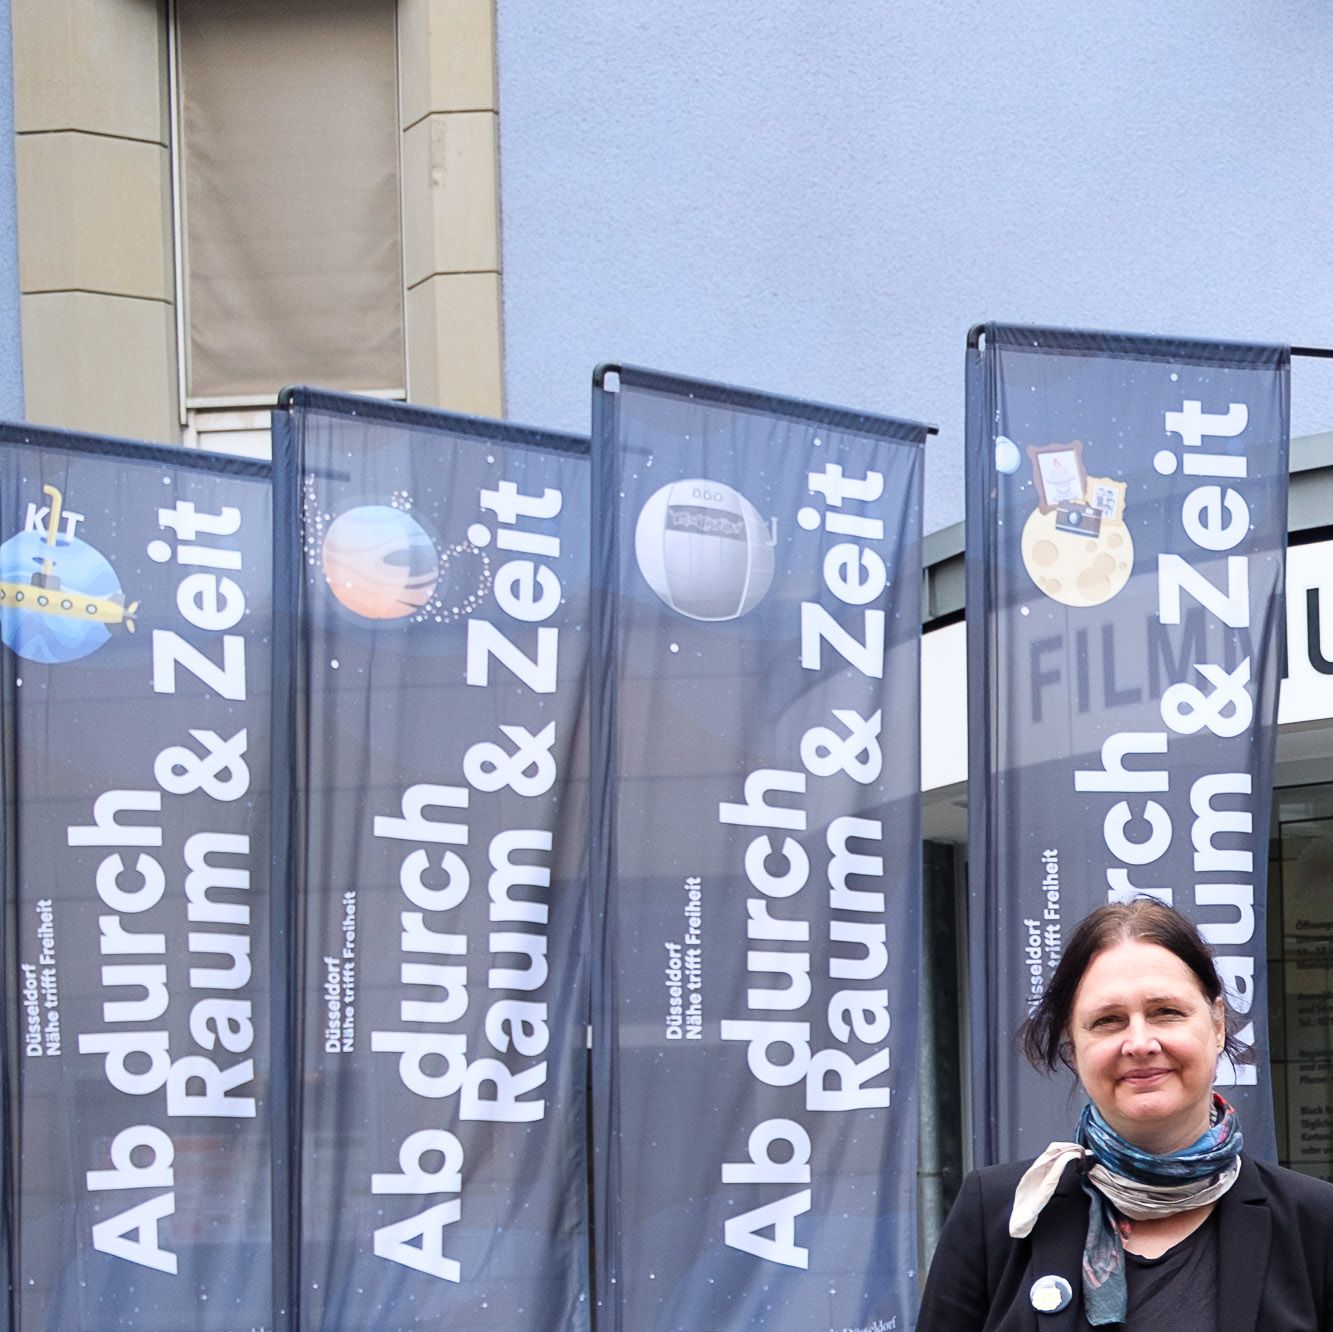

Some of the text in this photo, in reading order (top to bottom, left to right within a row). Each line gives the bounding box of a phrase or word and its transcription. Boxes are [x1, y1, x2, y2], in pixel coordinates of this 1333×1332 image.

[1154, 400, 1249, 627] Zeit
[1160, 656, 1253, 737] &
[147, 501, 256, 1117] Raum & Zeit
[459, 481, 562, 1122] Raum & Zeit
[797, 463, 890, 1111] Raum & Zeit
[684, 876, 702, 1040] Nähe trifft Freiheit
[1042, 848, 1060, 920] Freiheit
[21, 963, 43, 1057] Düsseldorf
[36, 898, 61, 1057] Nähe trifft Freiheit
[67, 790, 177, 1274] Ab durch
[324, 957, 341, 1053] Düsseldorf
[343, 891, 356, 1053] Nähe trifft Freiheit
[371, 784, 469, 1282] Ab durch
[664, 942, 682, 1040] Düsseldorf
[719, 769, 811, 1269] Ab durch
